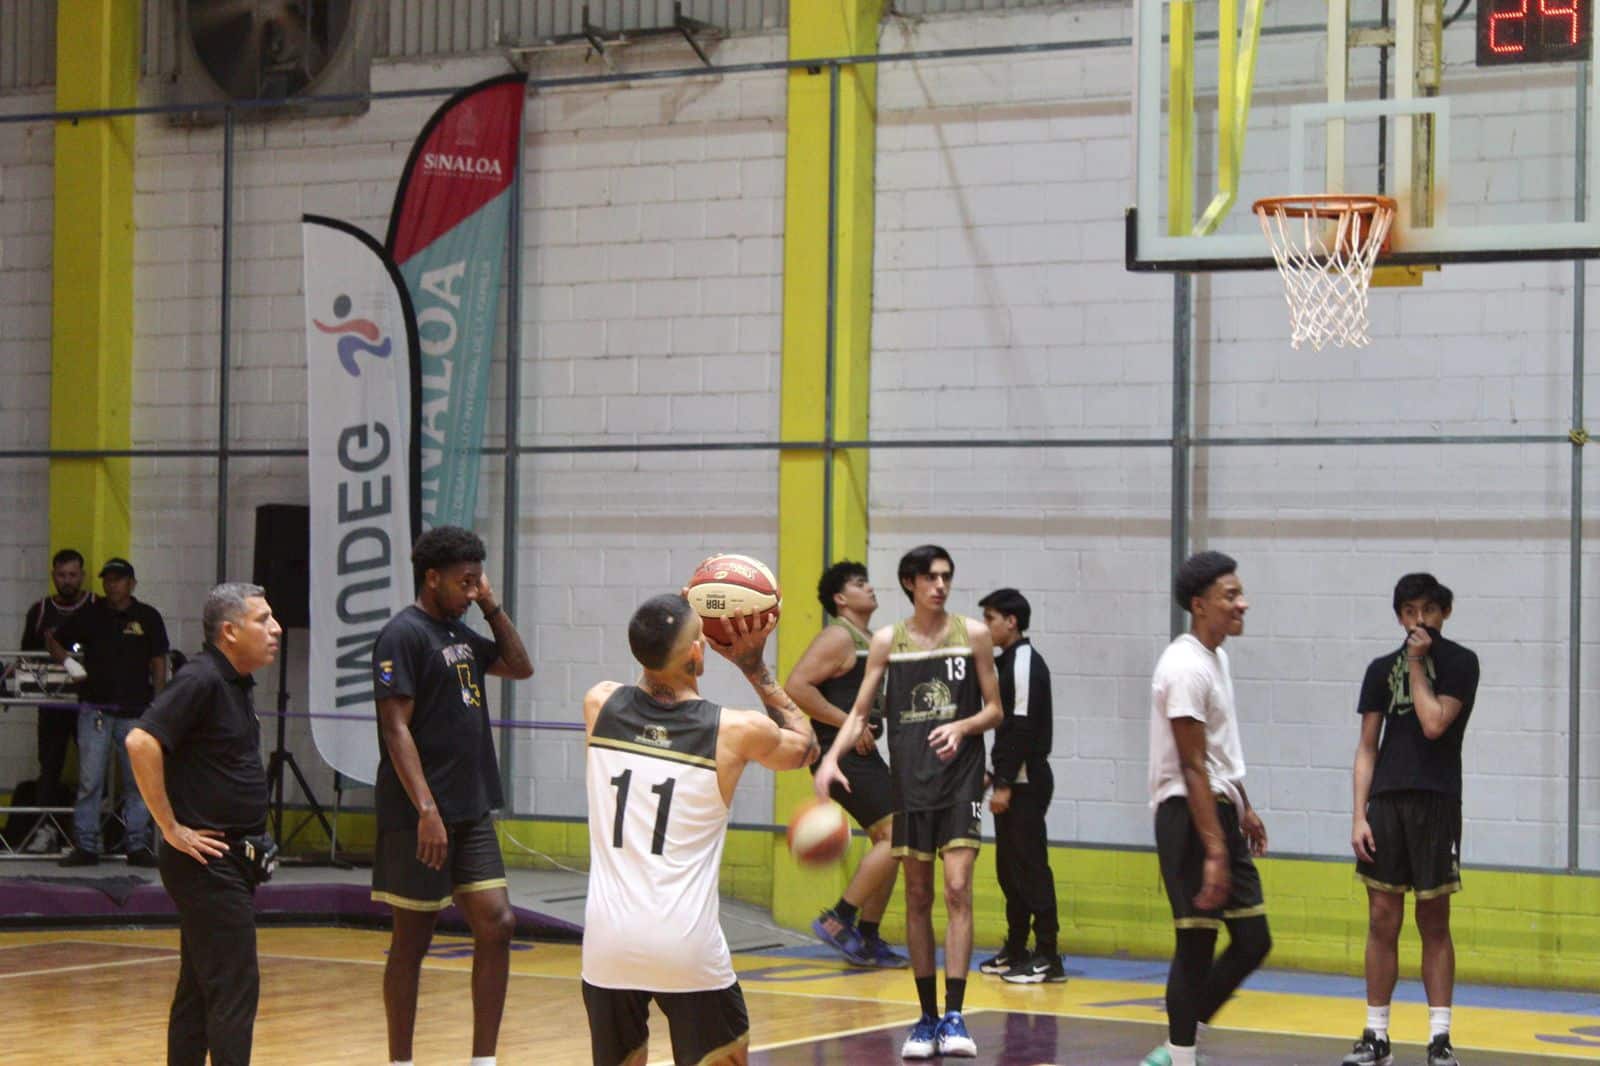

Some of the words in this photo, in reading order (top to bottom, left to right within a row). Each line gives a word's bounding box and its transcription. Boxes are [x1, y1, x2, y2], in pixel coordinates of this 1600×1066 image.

[1488, 0, 1577, 52] 24
[423, 153, 502, 176] SINALOA
[706, 599, 726, 610] FIBA
[945, 656, 966, 682] 13
[610, 768, 677, 856] 11
[970, 801, 985, 819] 13
